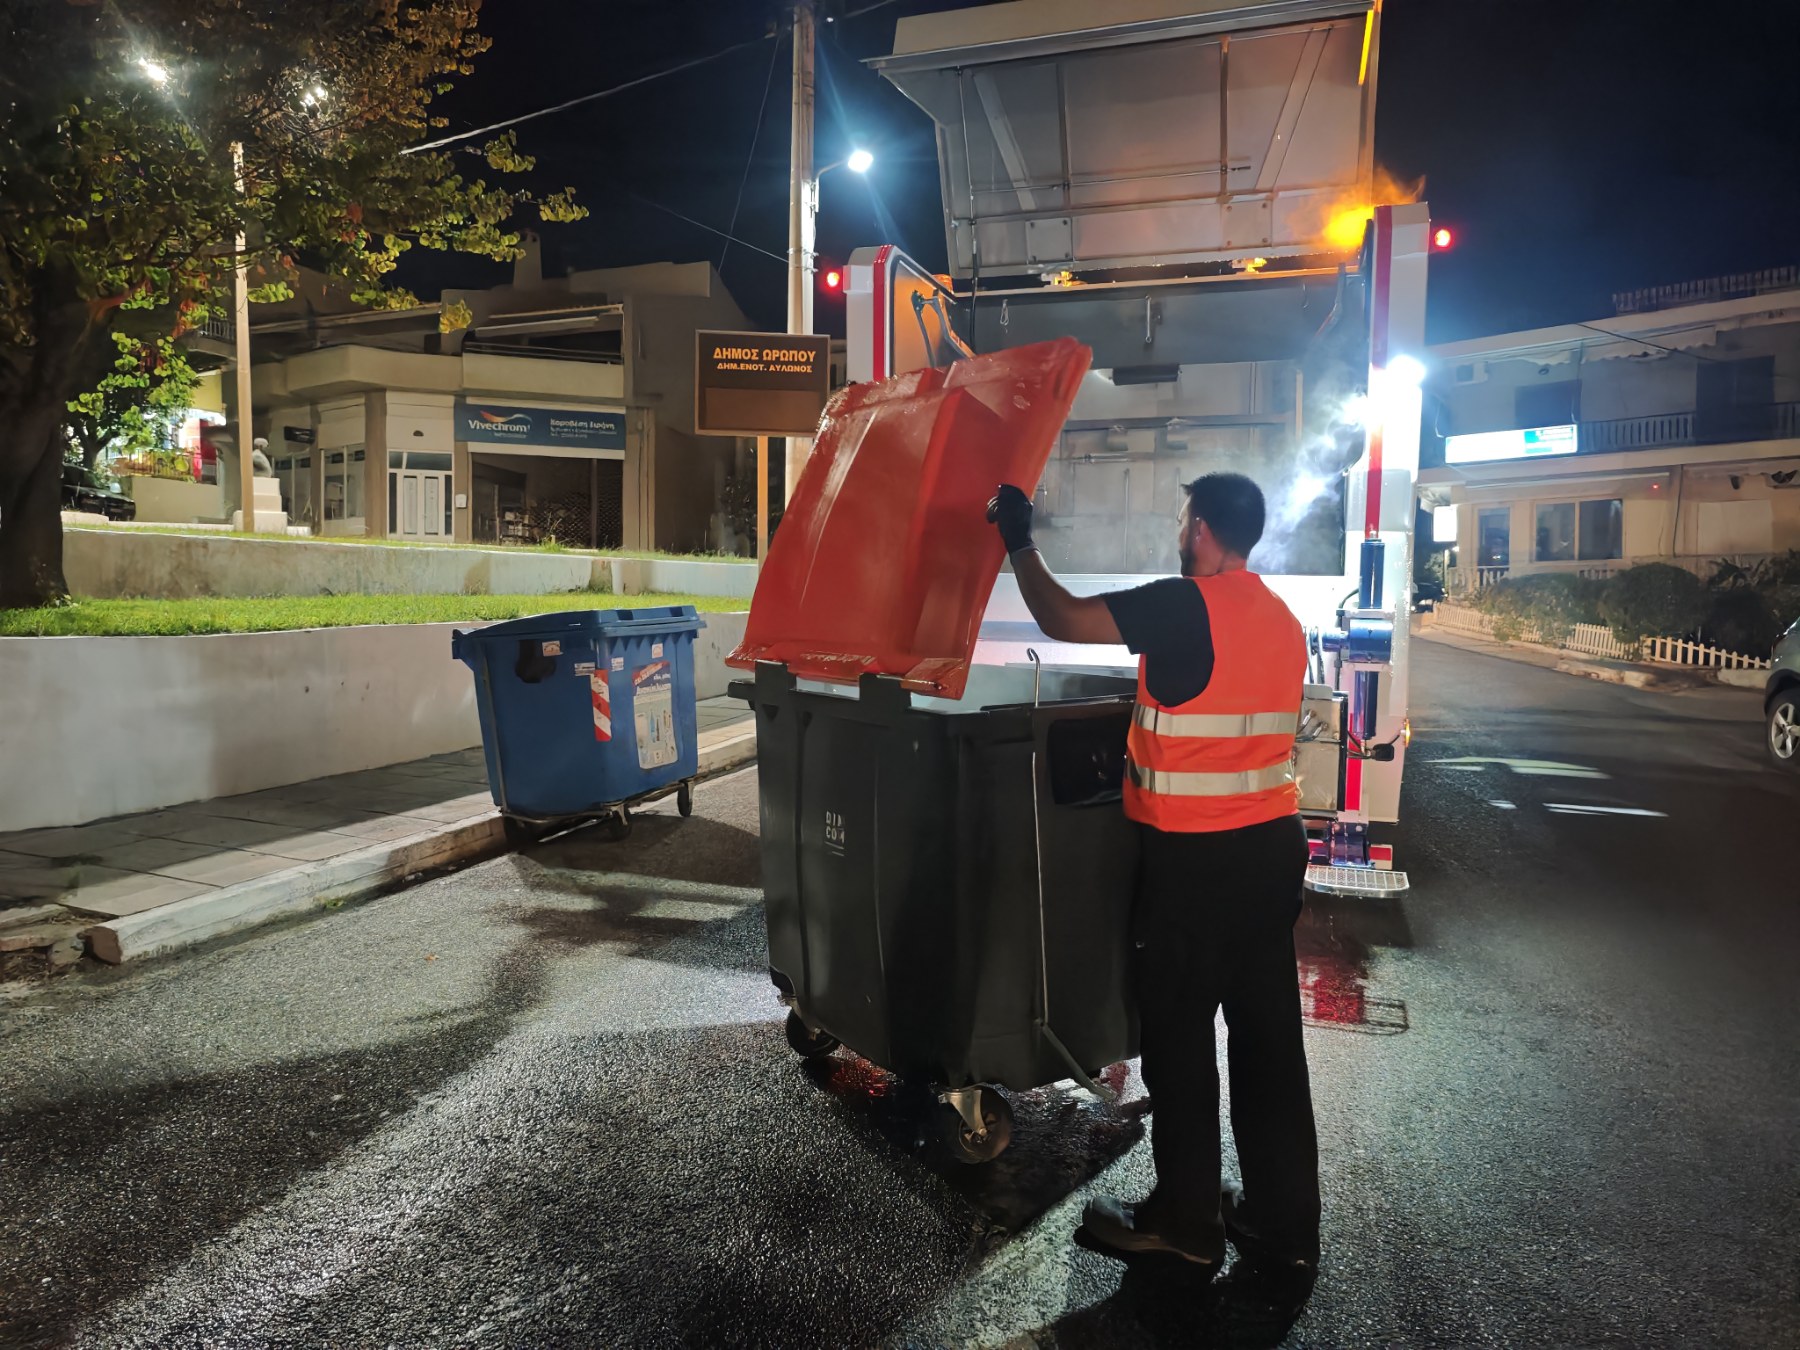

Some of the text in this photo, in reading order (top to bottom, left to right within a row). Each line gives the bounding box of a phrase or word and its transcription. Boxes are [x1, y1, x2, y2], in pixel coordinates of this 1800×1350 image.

[713, 347, 816, 362] ΔΗΜΟΣ ΩΡΩΠΟΥ
[769, 364, 812, 373] ΑΥΛΩΝΟΣ
[468, 419, 527, 433] Vivechrom
